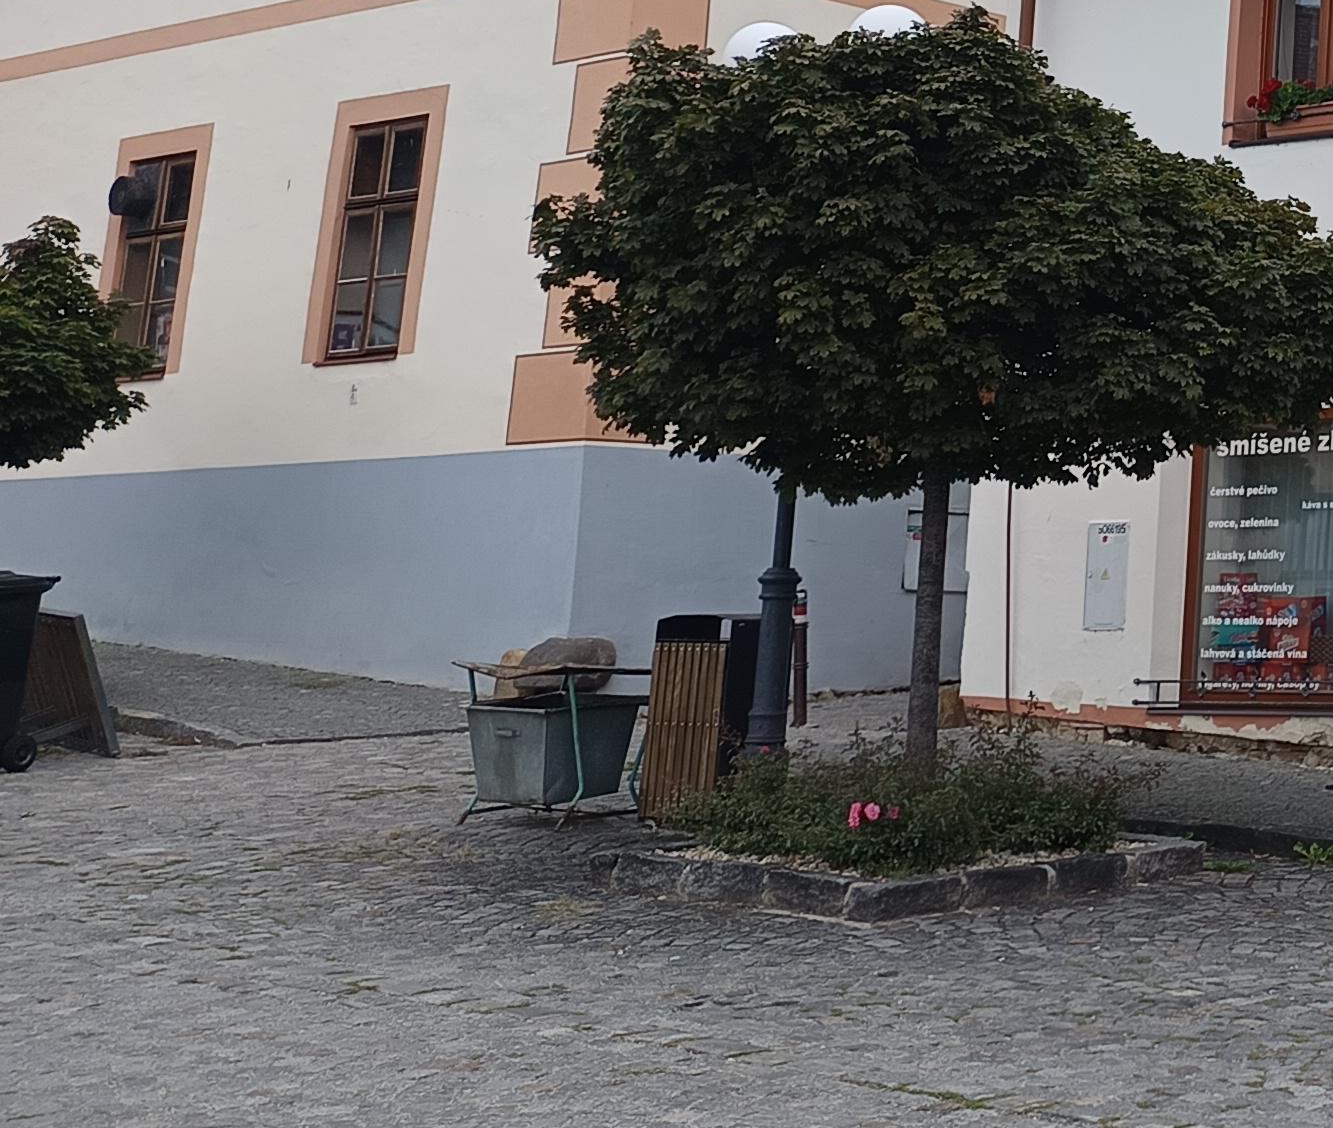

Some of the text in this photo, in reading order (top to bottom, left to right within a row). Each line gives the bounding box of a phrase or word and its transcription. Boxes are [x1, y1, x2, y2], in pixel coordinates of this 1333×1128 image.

[1216, 430, 1311, 457] smíšené
[1209, 484, 1278, 498] čerstvé pečivo
[1302, 500, 1321, 510] káva
[1208, 517, 1279, 529] ovoce, zelenina
[1205, 549, 1286, 562] zákusky, lahůdky
[1204, 582, 1294, 595] nanuky, cukrovinky
[1202, 614, 1298, 628] alko a nealko nápoje
[1200, 647, 1307, 659] lahvová a stáčená vína
